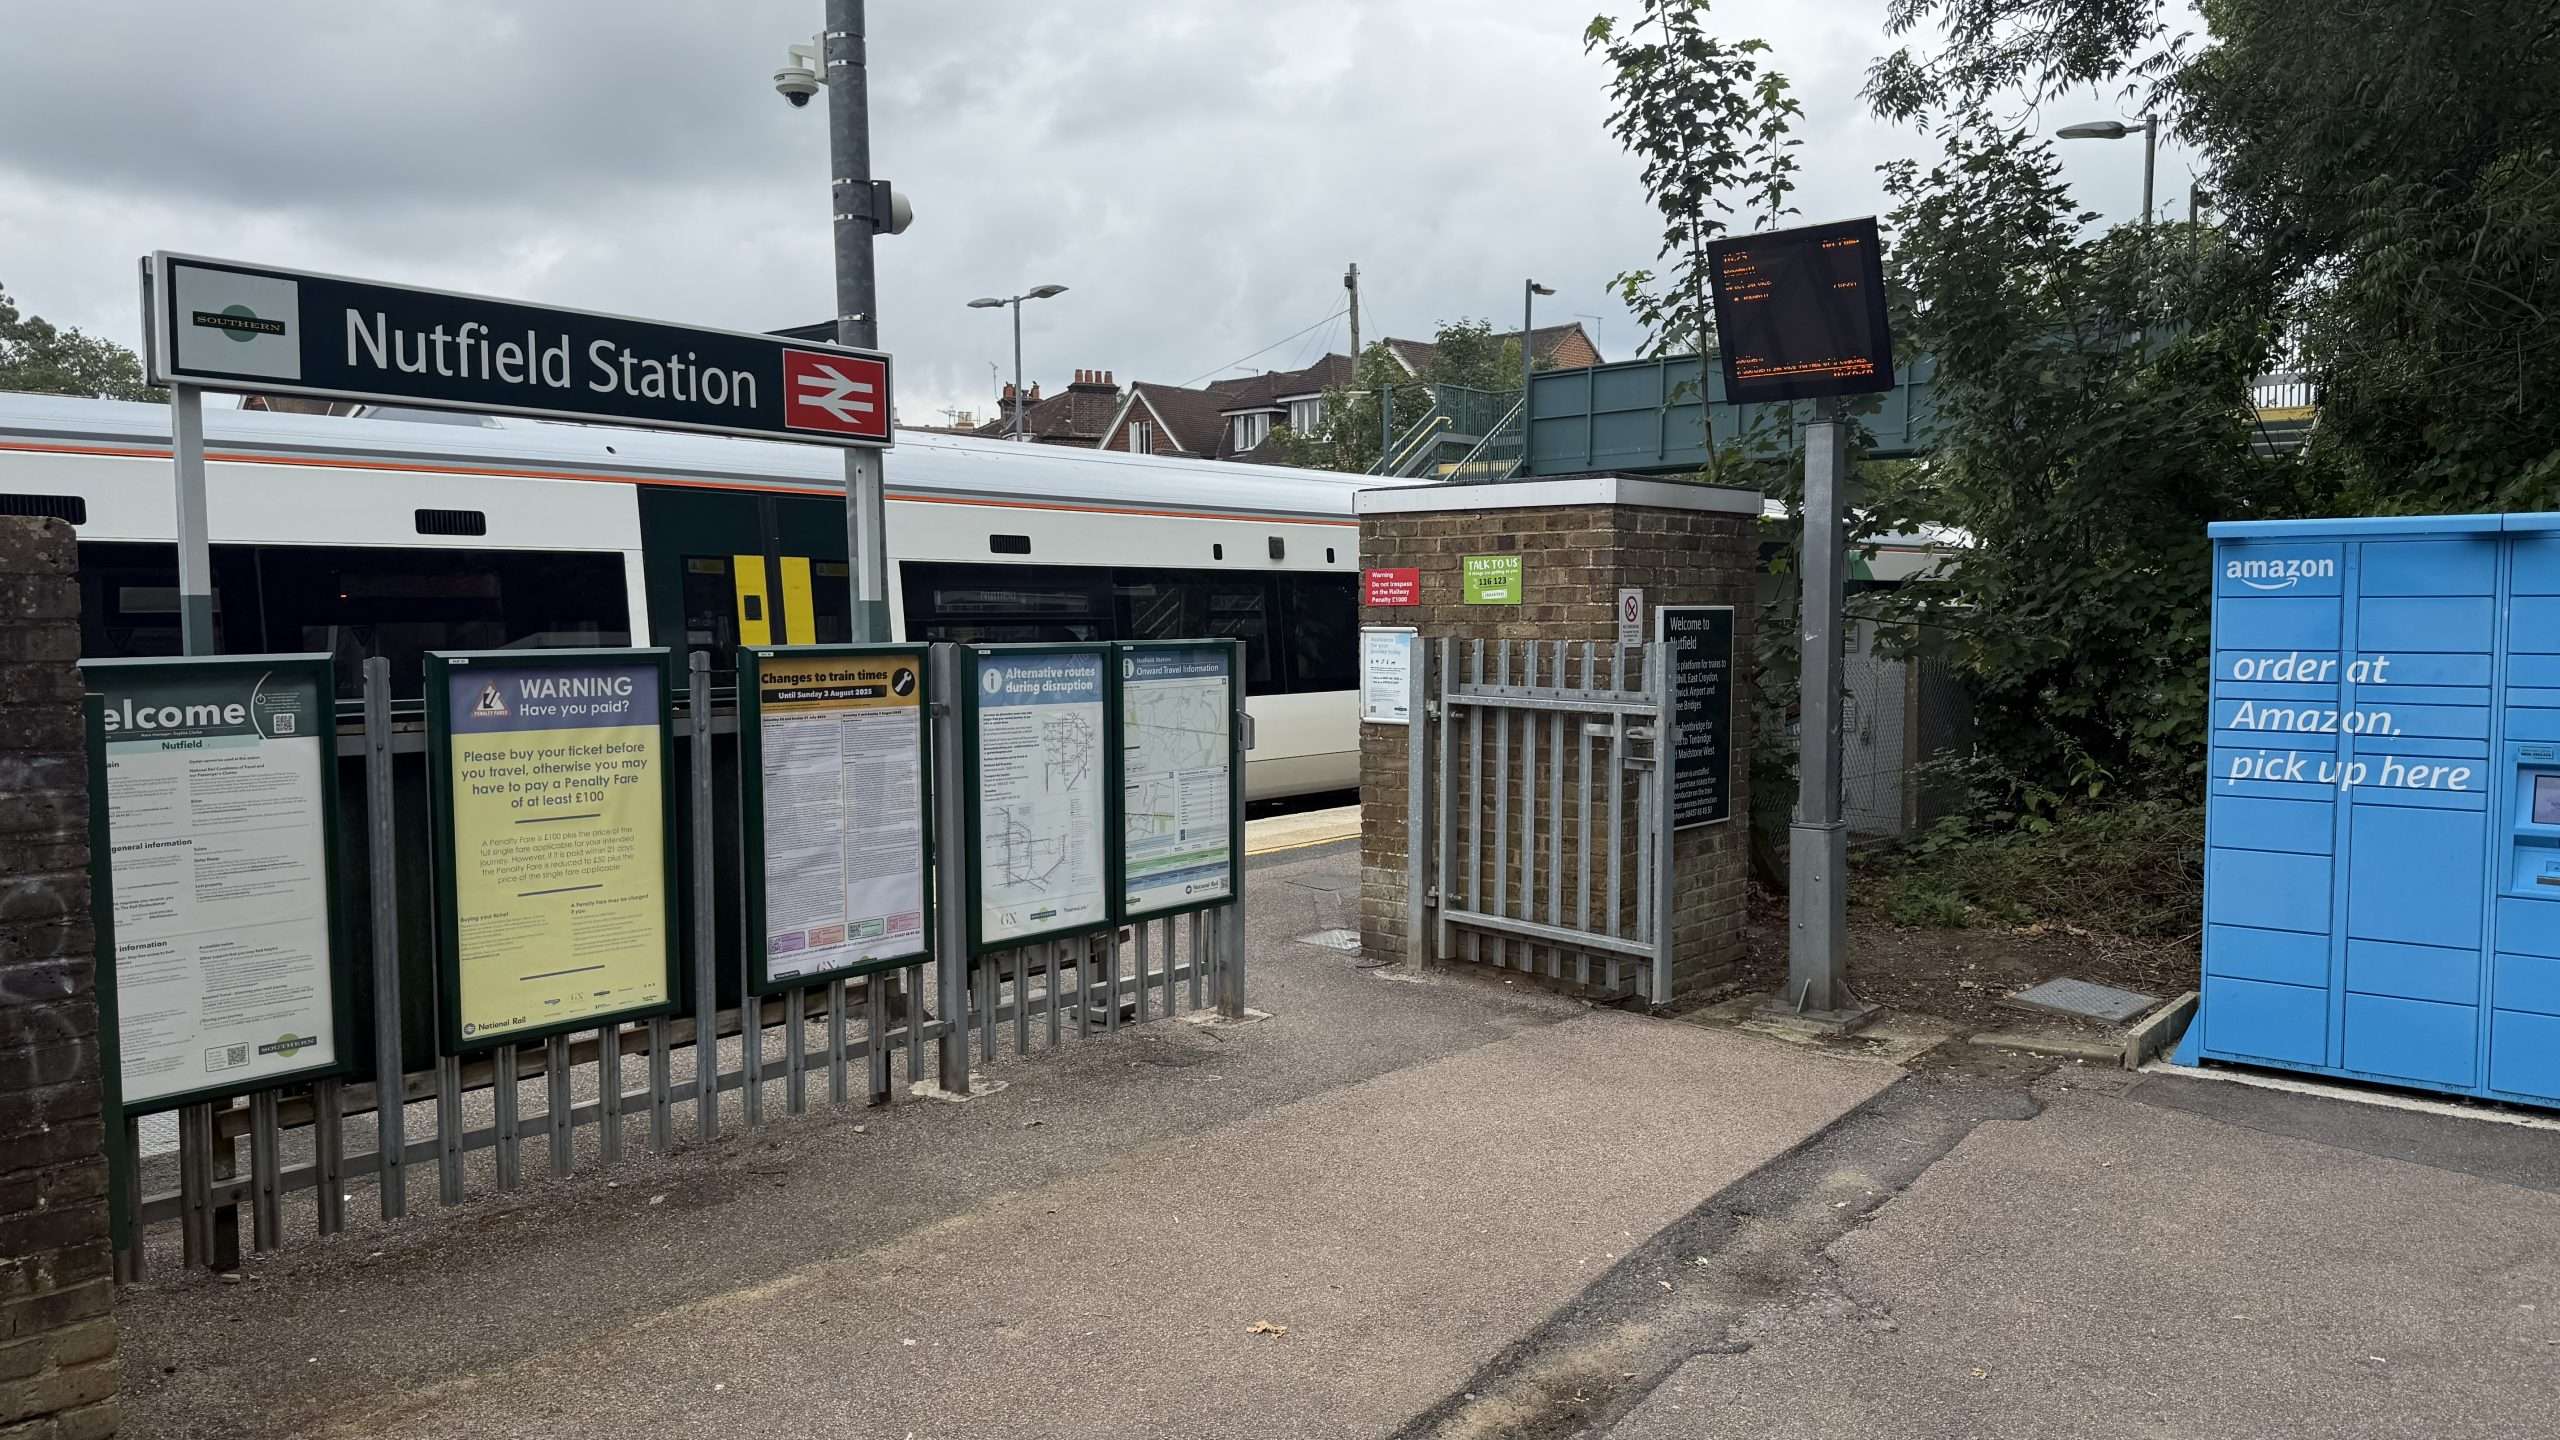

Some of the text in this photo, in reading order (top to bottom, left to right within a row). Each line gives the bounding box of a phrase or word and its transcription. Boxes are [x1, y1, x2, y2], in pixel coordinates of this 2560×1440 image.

[197, 315, 280, 332] SOUTHERN
[346, 308, 757, 409] Nutfield Station
[1469, 558, 1518, 570] TALK TO US
[2226, 559, 2334, 579] amazon
[1479, 576, 1507, 586] 116 123
[1389, 588, 1409, 596] Railway
[1670, 616, 1710, 631] Welcome to
[1006, 667, 1096, 679] Alternative routes
[1136, 664, 1219, 676] Onward Travel Information
[2233, 651, 2390, 684] order at
[761, 669, 888, 685] Changes to train times
[520, 677, 633, 699] WARNING
[779, 691, 796, 699] Until
[797, 690, 823, 700] Sunday
[830, 689, 854, 698] August
[1006, 679, 1093, 695] during disruption
[520, 700, 630, 718] Have you paid?
[2229, 700, 2401, 740] Amazon,
[162, 740, 202, 750] Nutfield
[464, 742, 645, 763] Please buy your ticket before
[461, 758, 648, 782] you travel, otherwise you may
[2228, 750, 2471, 792] pick up here
[472, 773, 639, 795] have to pay a Penalty Fare
[511, 790, 604, 809] of at least £100
[111, 839, 192, 854] general information
[119, 940, 168, 952] information
[478, 1015, 527, 1031] National Rail
